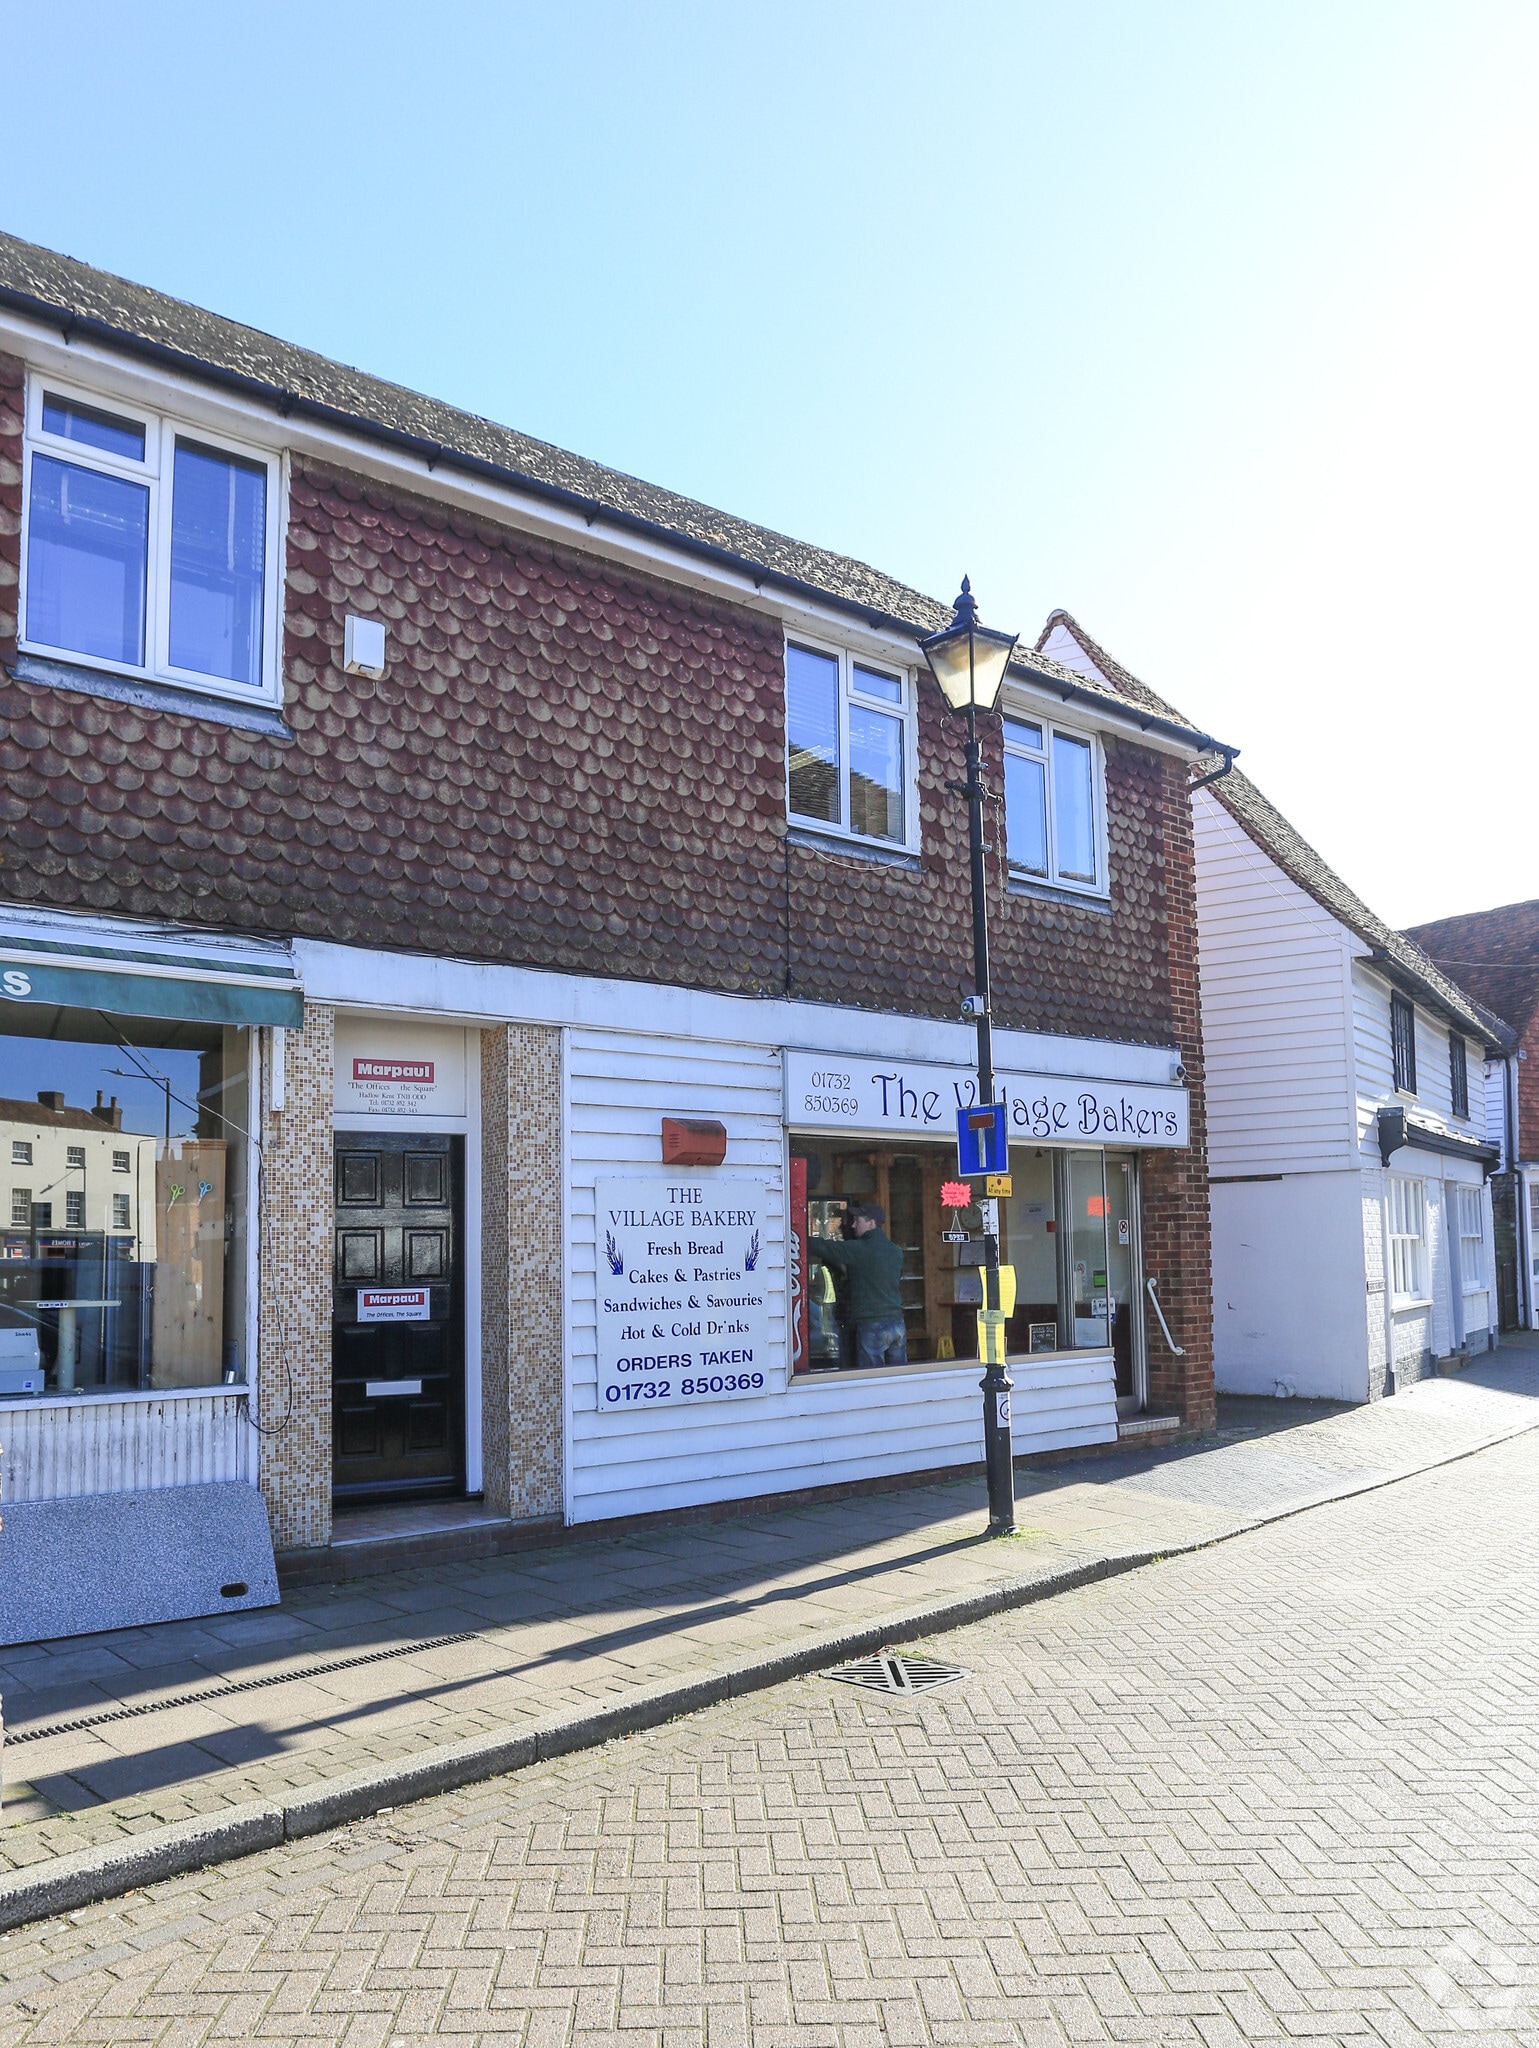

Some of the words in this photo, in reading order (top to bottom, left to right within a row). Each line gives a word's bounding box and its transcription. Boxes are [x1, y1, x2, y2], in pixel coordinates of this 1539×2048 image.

[357, 1063, 430, 1077] Marpaul
[366, 1083, 390, 1091] Offices
[811, 1071, 851, 1090] 01732
[804, 1094, 859, 1116] 850369
[871, 1073, 942, 1125] The
[952, 1080, 1069, 1137] Vage
[1077, 1093, 1178, 1138] Bakers
[667, 1187, 703, 1204] THE
[609, 1210, 685, 1227] VILLAGE
[691, 1210, 757, 1227] BAKERY
[647, 1241, 682, 1256] Fresh
[687, 1240, 724, 1255] Bread
[628, 1269, 669, 1284] Cakes
[674, 1268, 688, 1282] &
[693, 1267, 741, 1282] Pastries
[369, 1294, 419, 1304] Marpaul
[604, 1296, 682, 1313] Sandwiches
[687, 1294, 701, 1309] &
[706, 1293, 763, 1308] Savouries
[620, 1325, 646, 1340] Hot
[651, 1323, 666, 1338] &
[671, 1322, 701, 1337] Cold
[707, 1319, 750, 1335] Drnks
[616, 1353, 692, 1373] ORDERS
[699, 1348, 753, 1366] TAKEN
[605, 1380, 671, 1403] 01732
[680, 1372, 764, 1396] 850369
